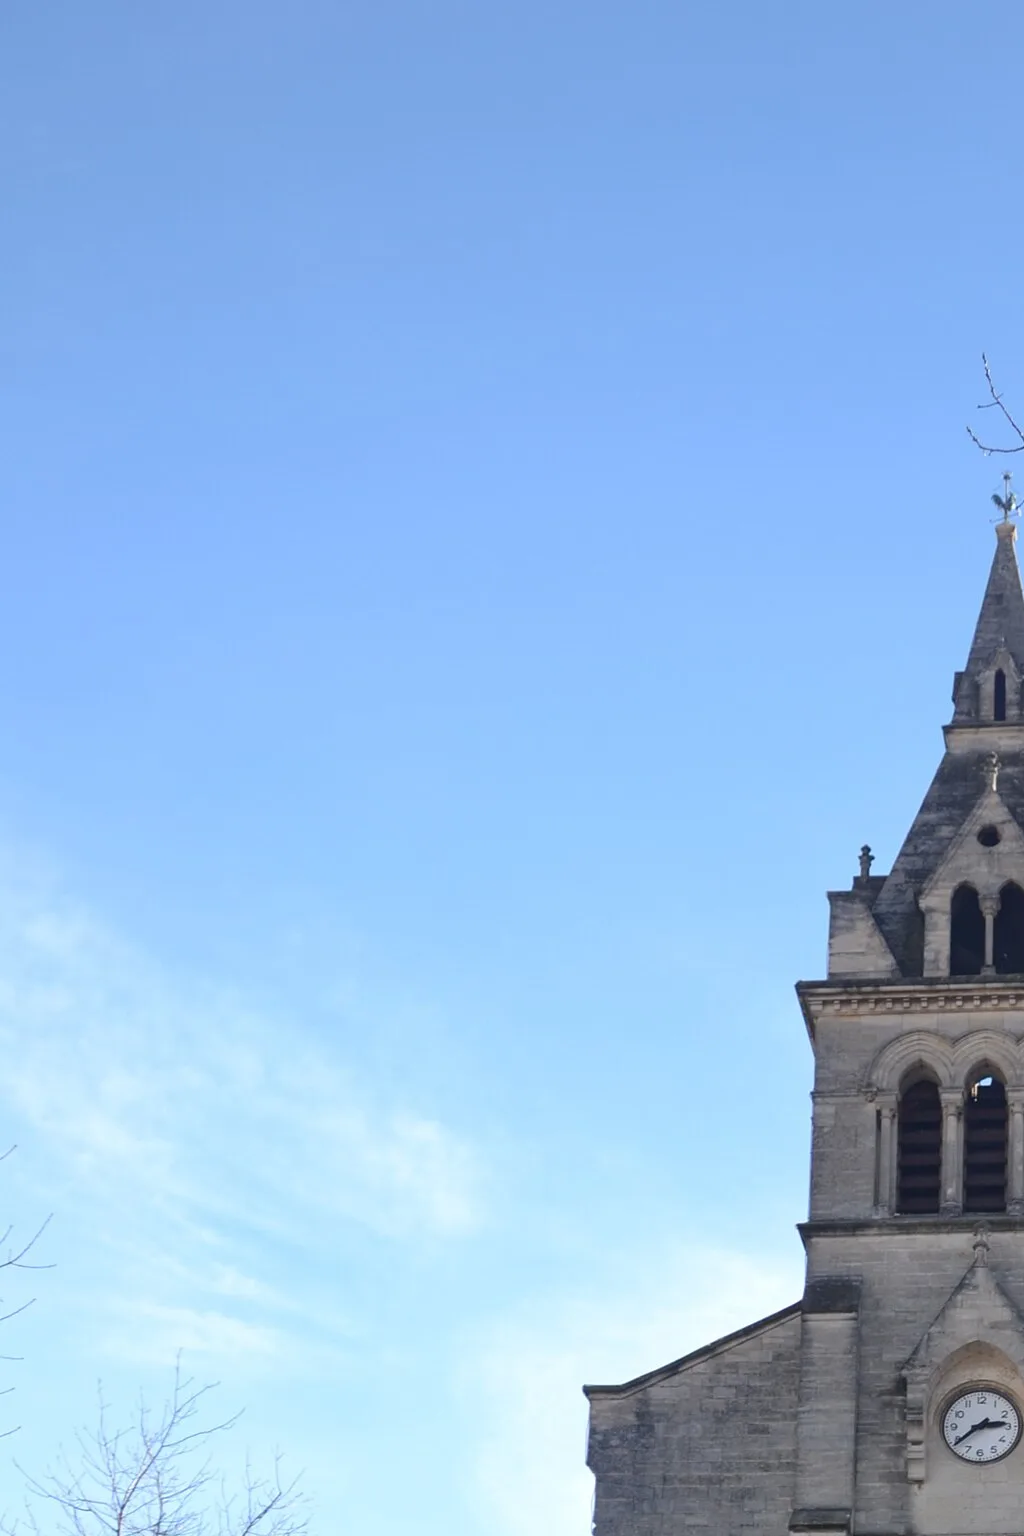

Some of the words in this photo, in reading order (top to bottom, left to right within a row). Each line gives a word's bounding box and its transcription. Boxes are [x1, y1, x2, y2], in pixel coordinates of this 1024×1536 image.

[965, 1400, 971, 1408] 11
[977, 1396, 987, 1404] 12
[994, 1400, 997, 1408] 1
[955, 1410, 964, 1418] 10
[1001, 1410, 1008, 1418] 2
[950, 1423, 958, 1431] 9
[1004, 1422, 1011, 1430] 3
[965, 1445, 972, 1454] 7
[976, 1449, 984, 1457] 6
[990, 1445, 997, 1453] 5
